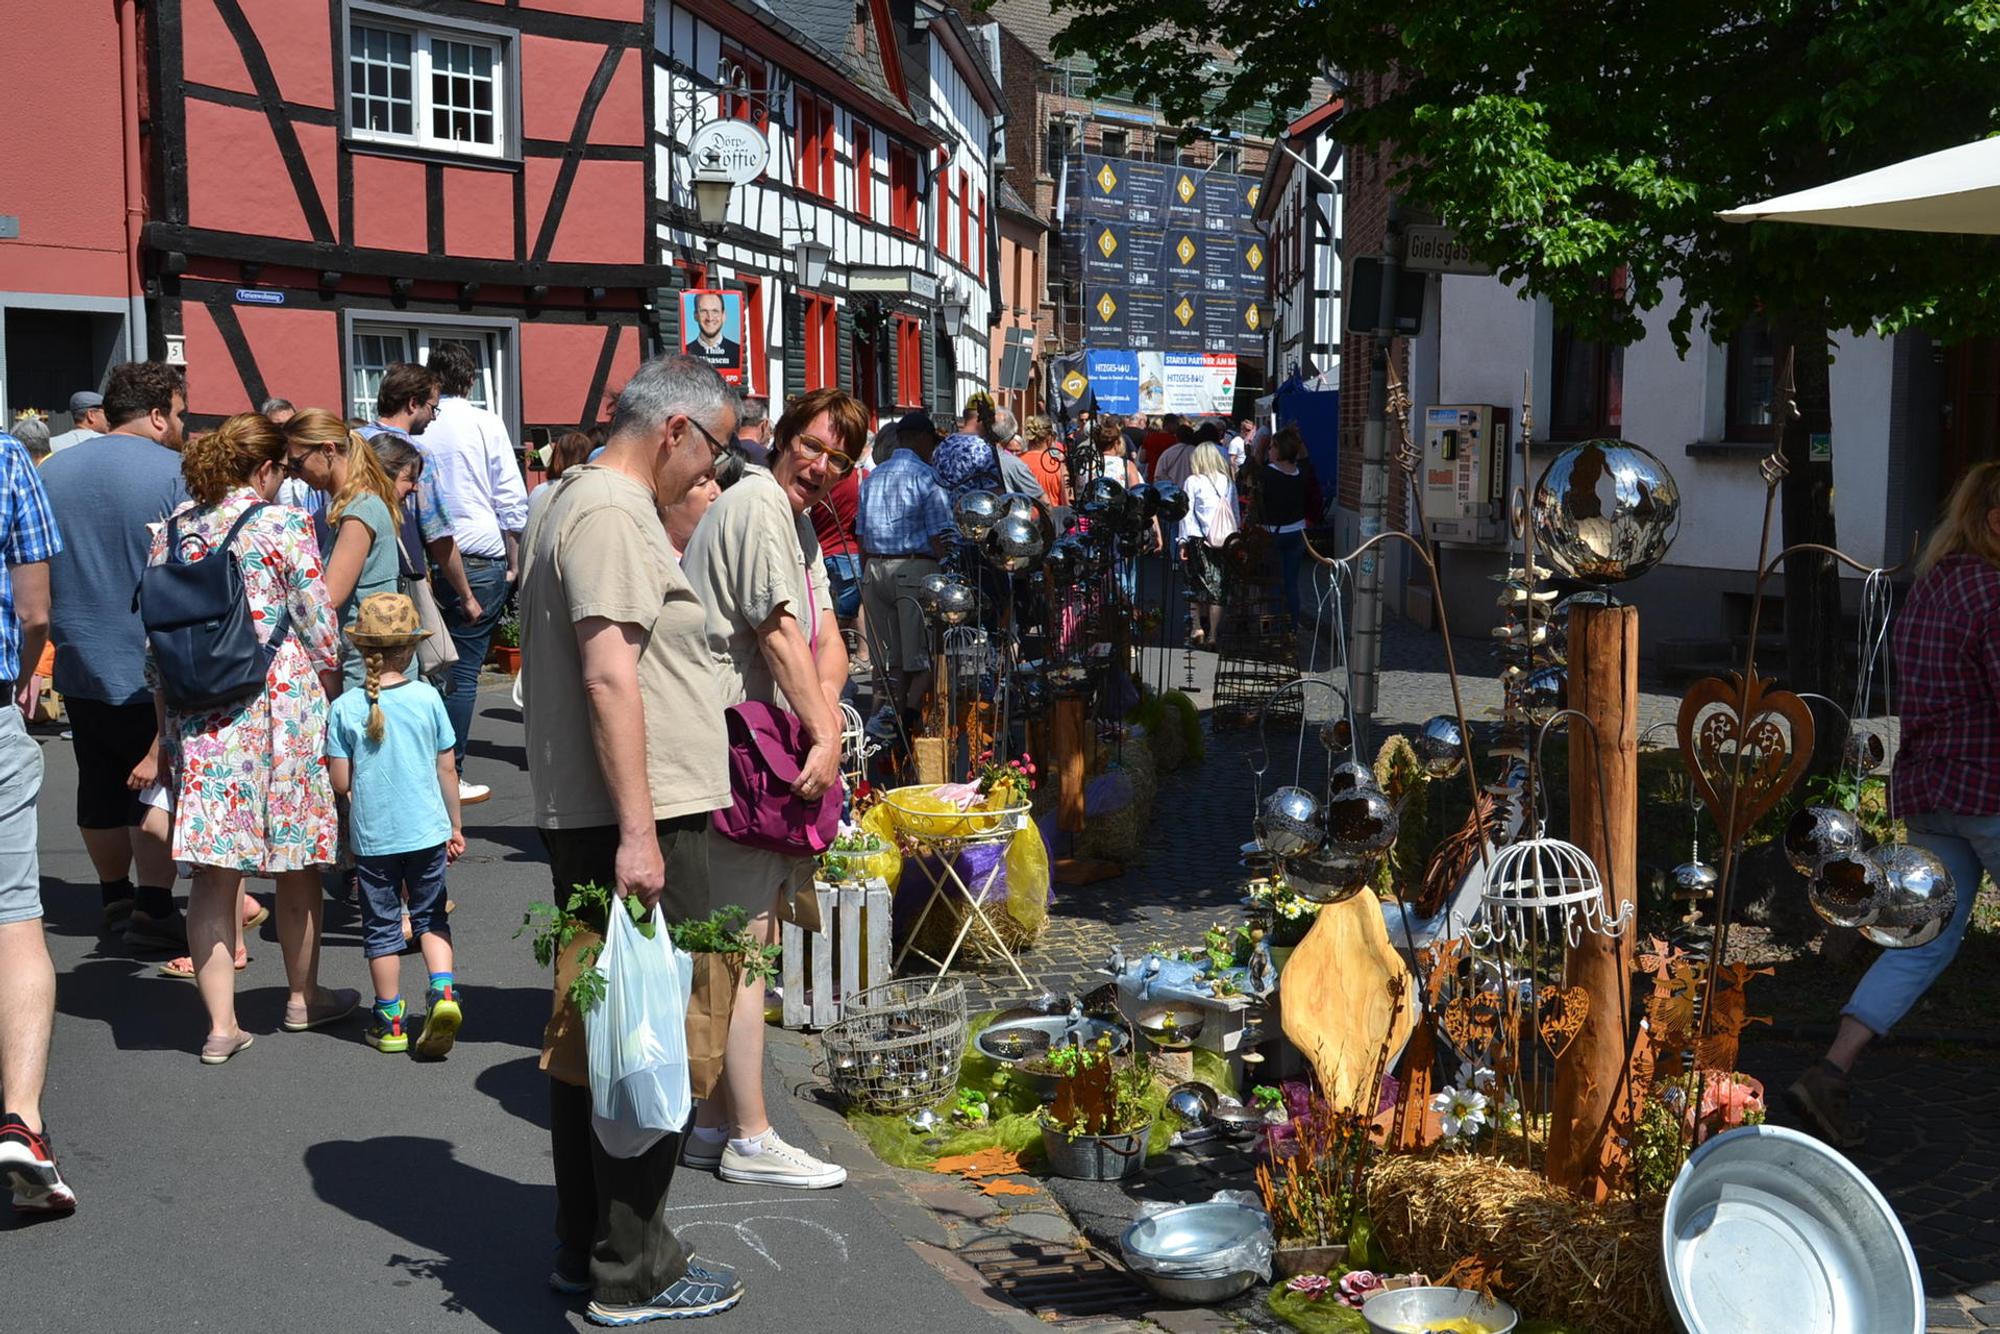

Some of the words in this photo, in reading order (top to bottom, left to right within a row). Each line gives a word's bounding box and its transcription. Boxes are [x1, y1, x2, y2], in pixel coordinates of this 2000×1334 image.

[1411, 234, 1469, 266] Gielsgas
[172, 345, 178, 357] 5
[1166, 357, 1187, 365] STARKE
[1188, 357, 1215, 366] PARTNER
[1216, 358, 1226, 366] AM
[1495, 426, 1504, 495] CIGARETTEN
